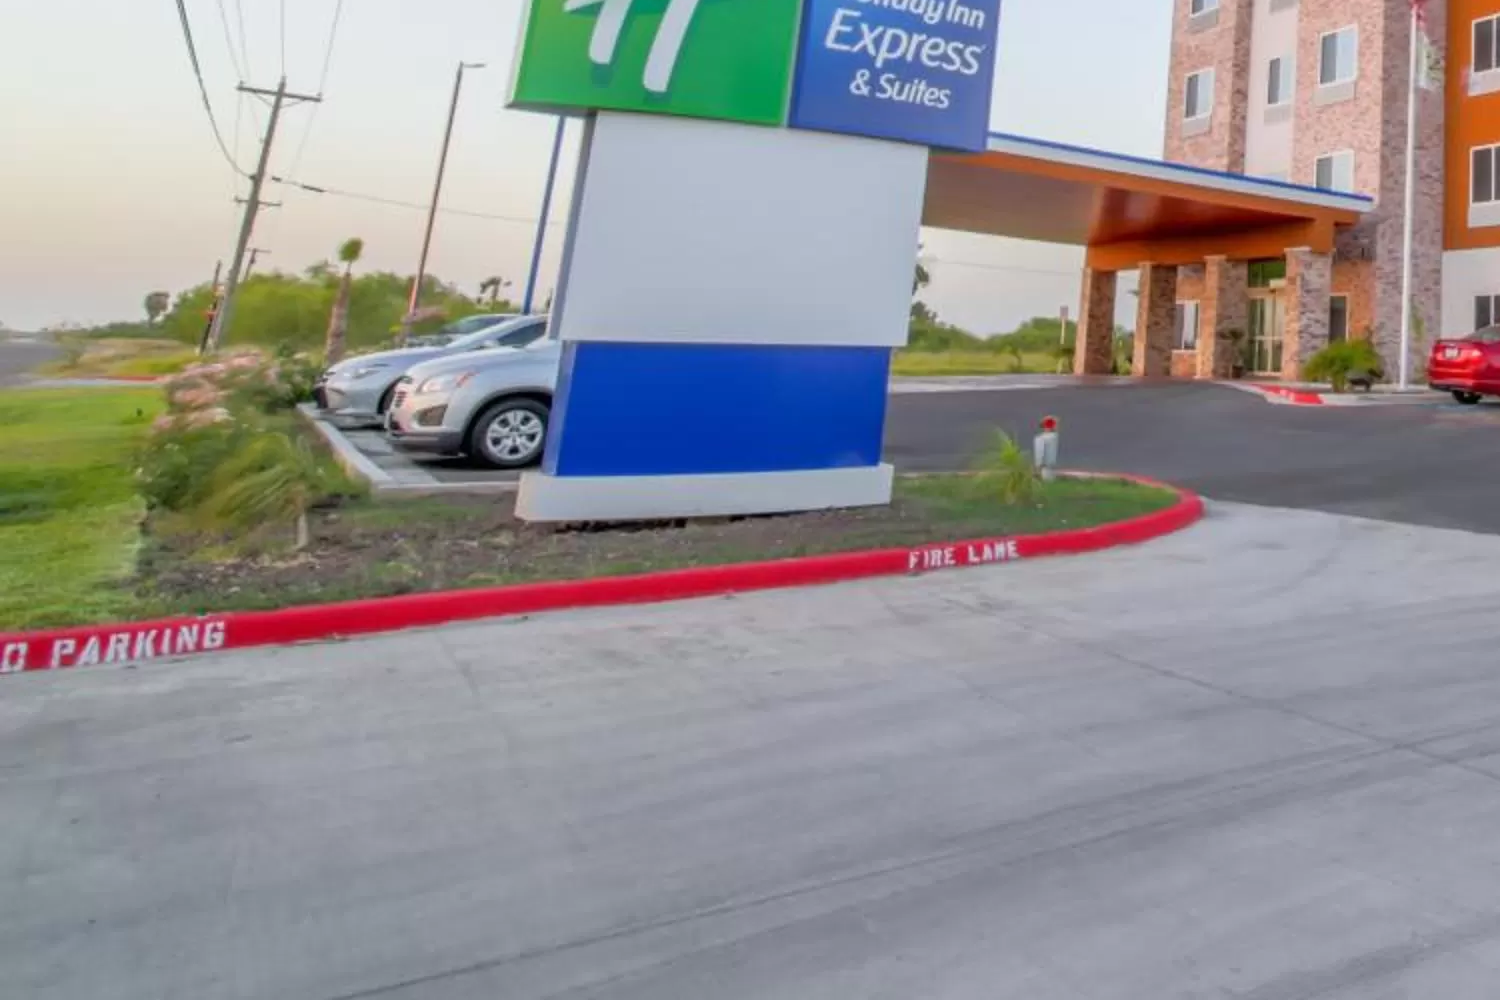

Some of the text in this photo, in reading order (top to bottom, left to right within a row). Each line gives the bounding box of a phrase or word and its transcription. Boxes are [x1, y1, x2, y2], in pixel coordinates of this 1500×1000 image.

[825, 8, 982, 75] Express
[849, 69, 951, 109] & Suites
[909, 540, 1020, 569] FIRE LANE
[0, 621, 226, 672] O PARKING
